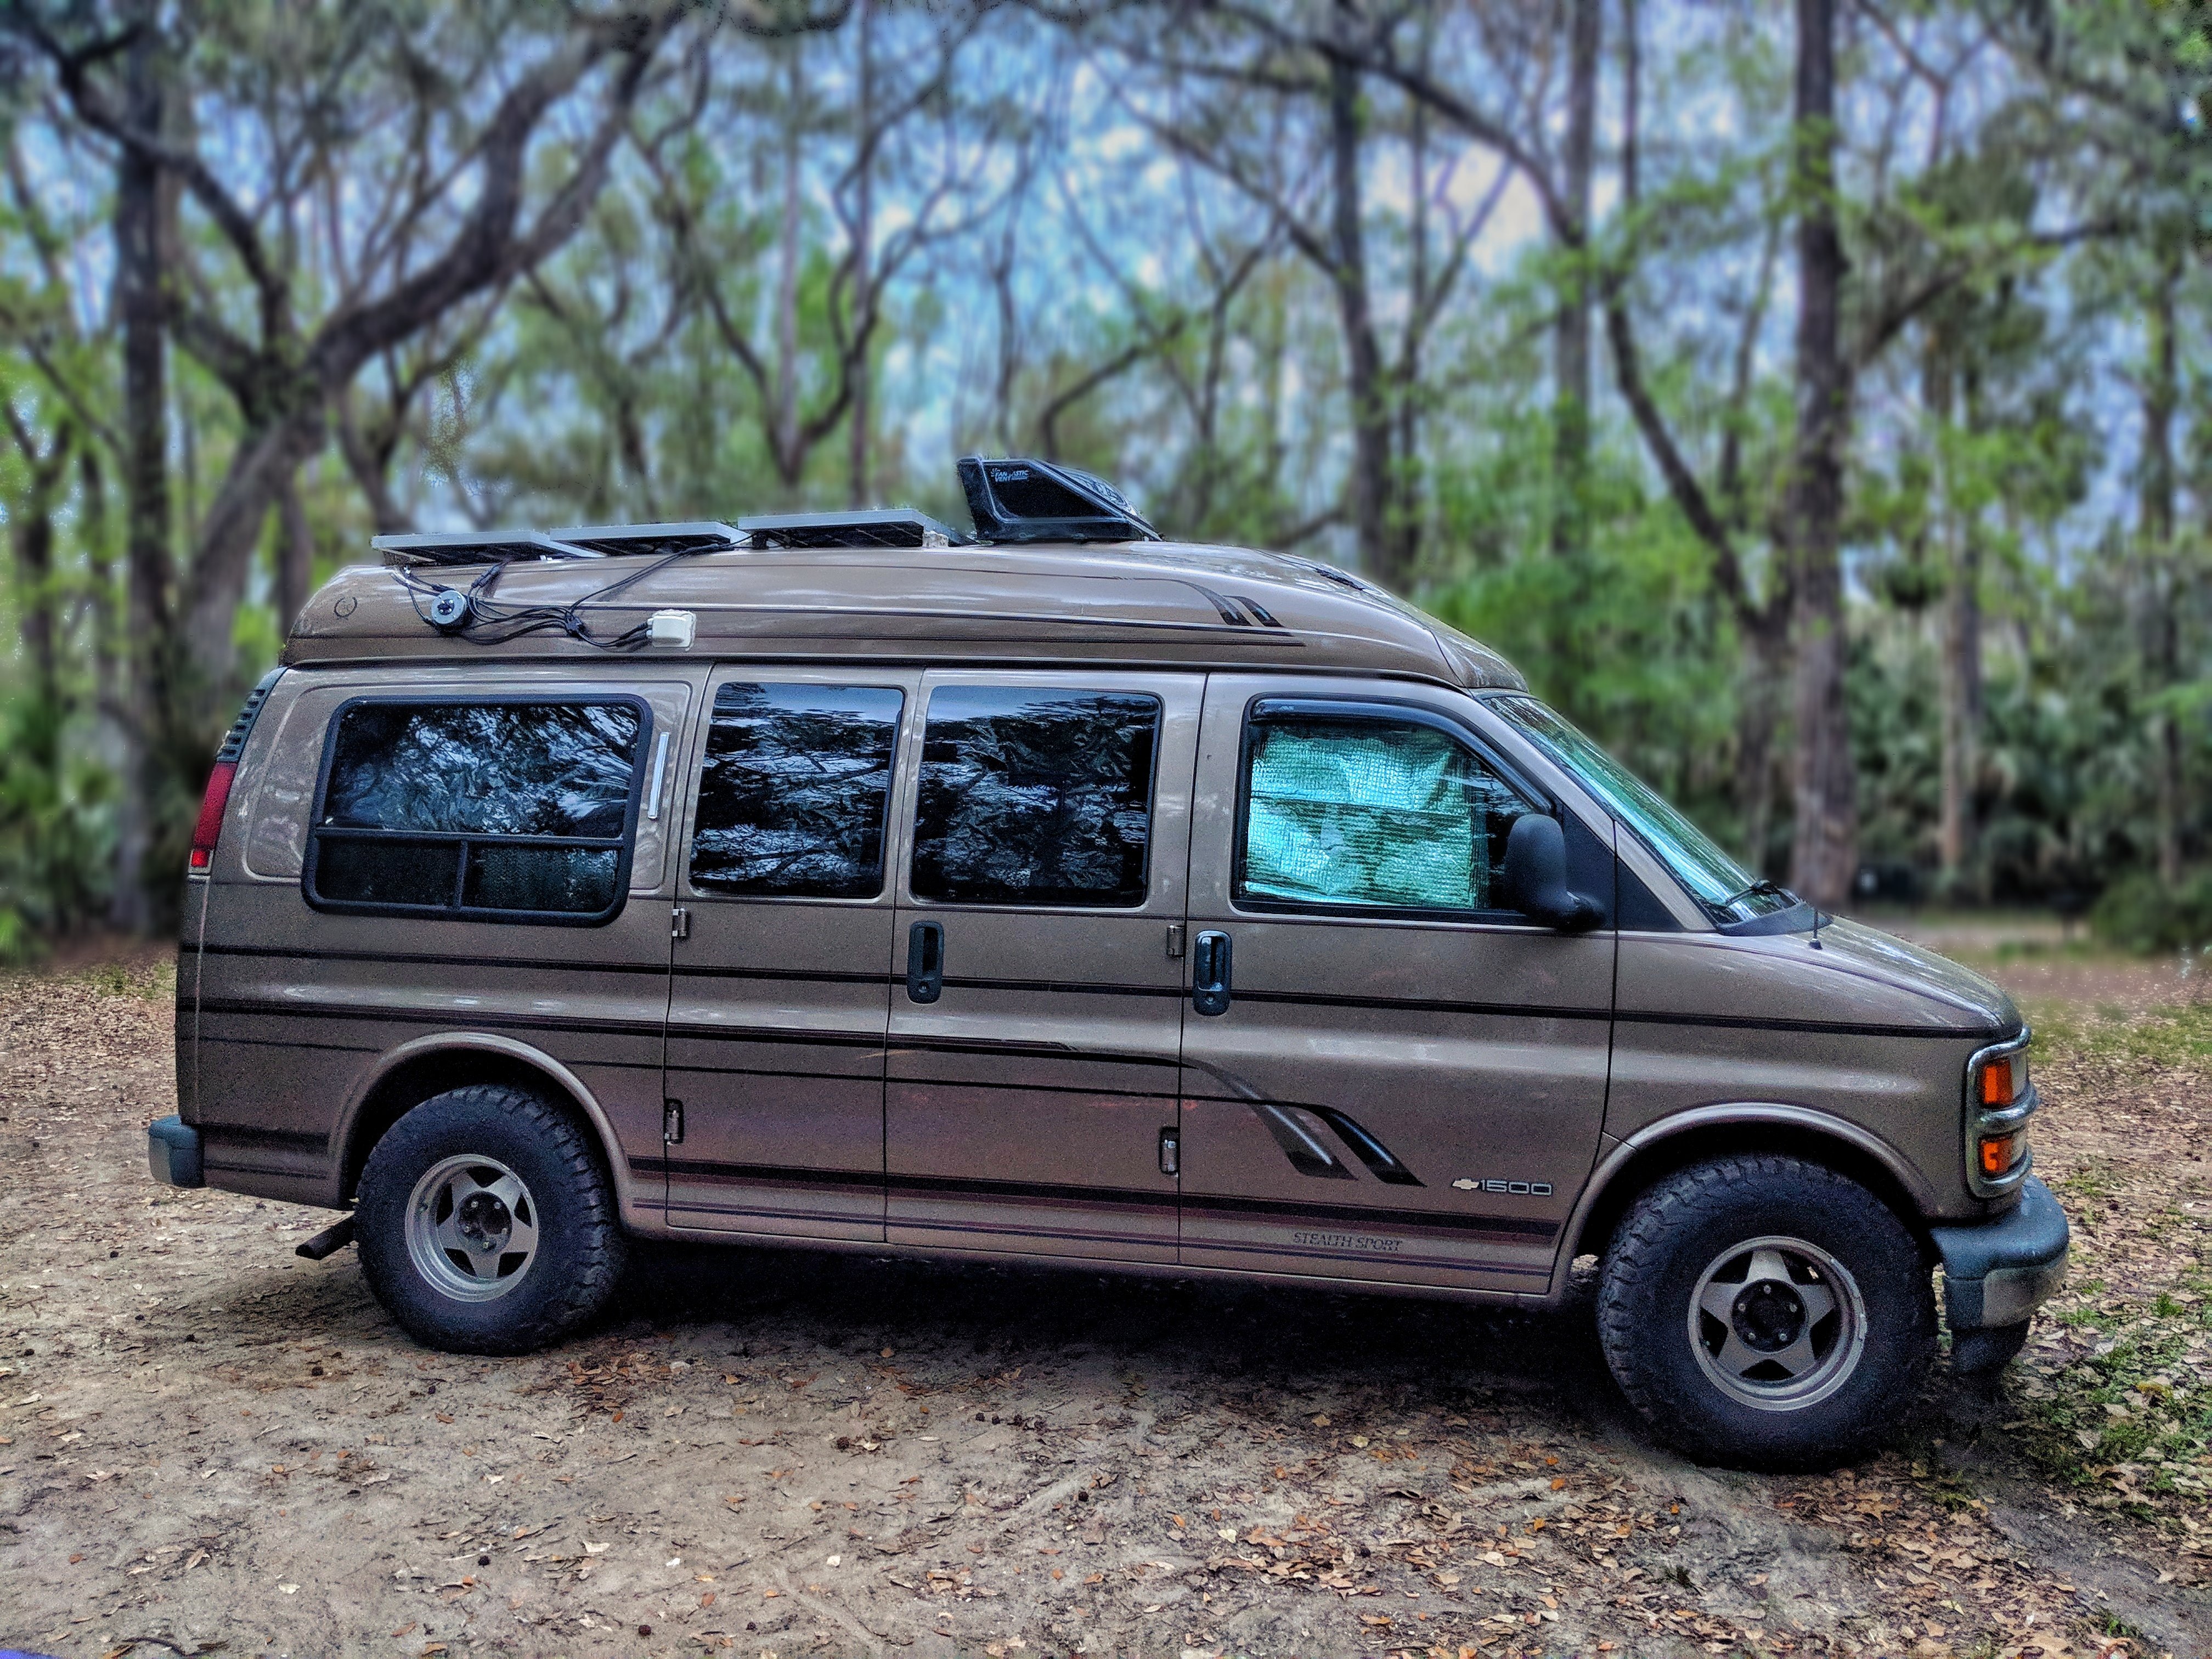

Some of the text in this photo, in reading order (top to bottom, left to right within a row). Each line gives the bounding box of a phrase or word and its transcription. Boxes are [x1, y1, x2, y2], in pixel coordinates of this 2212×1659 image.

[1481, 1180, 1551, 1195] 1500
[1294, 1232, 1403, 1251] STEALTH SPORT
